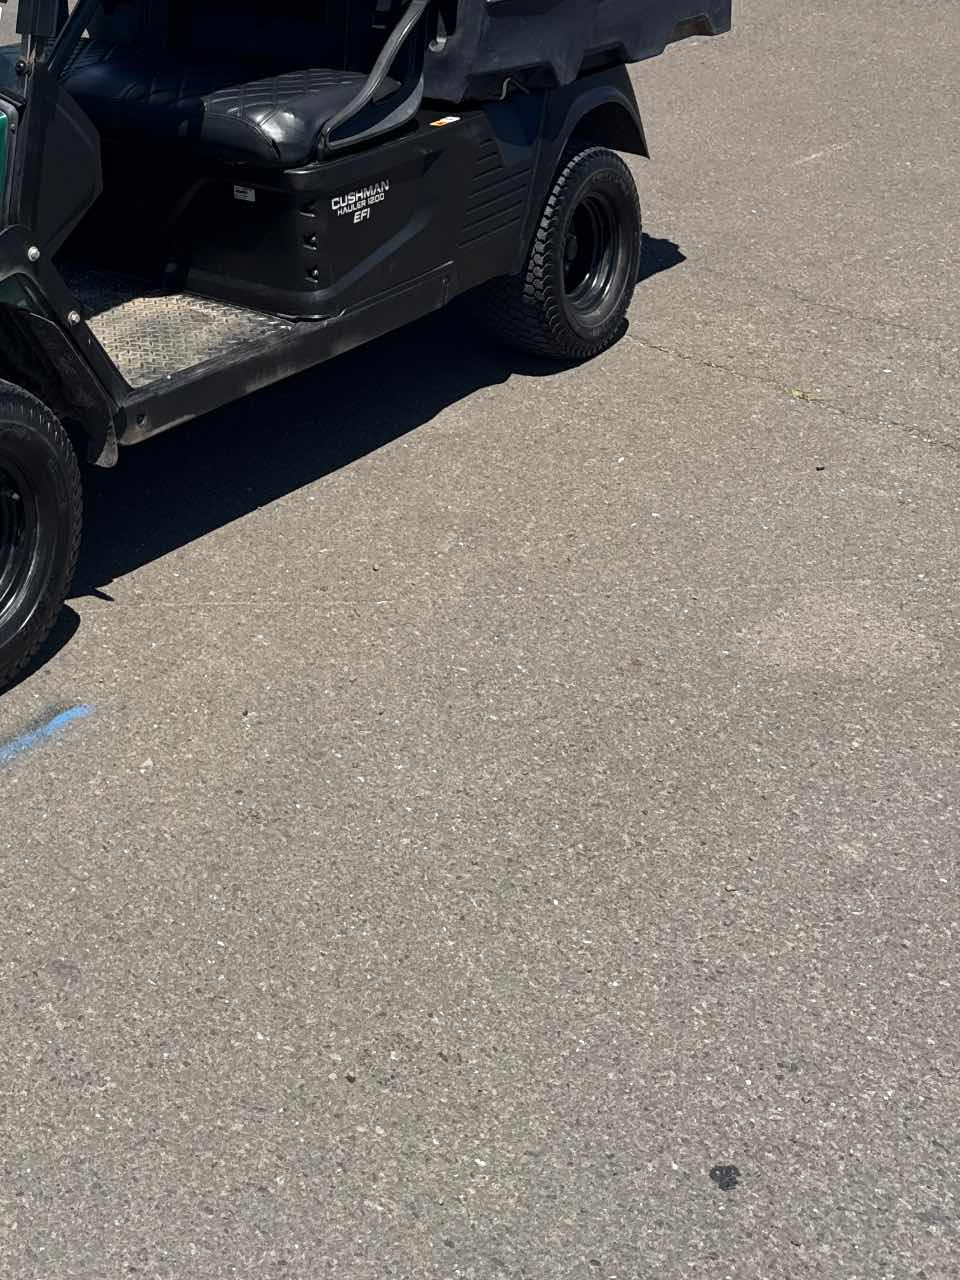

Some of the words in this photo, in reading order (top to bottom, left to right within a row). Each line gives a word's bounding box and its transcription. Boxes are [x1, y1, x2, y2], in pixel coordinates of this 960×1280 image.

[331, 179, 389, 210] CUSHMAN
[338, 200, 366, 216] HAULER
[368, 193, 385, 205] 1200
[353, 208, 370, 223] EFI
